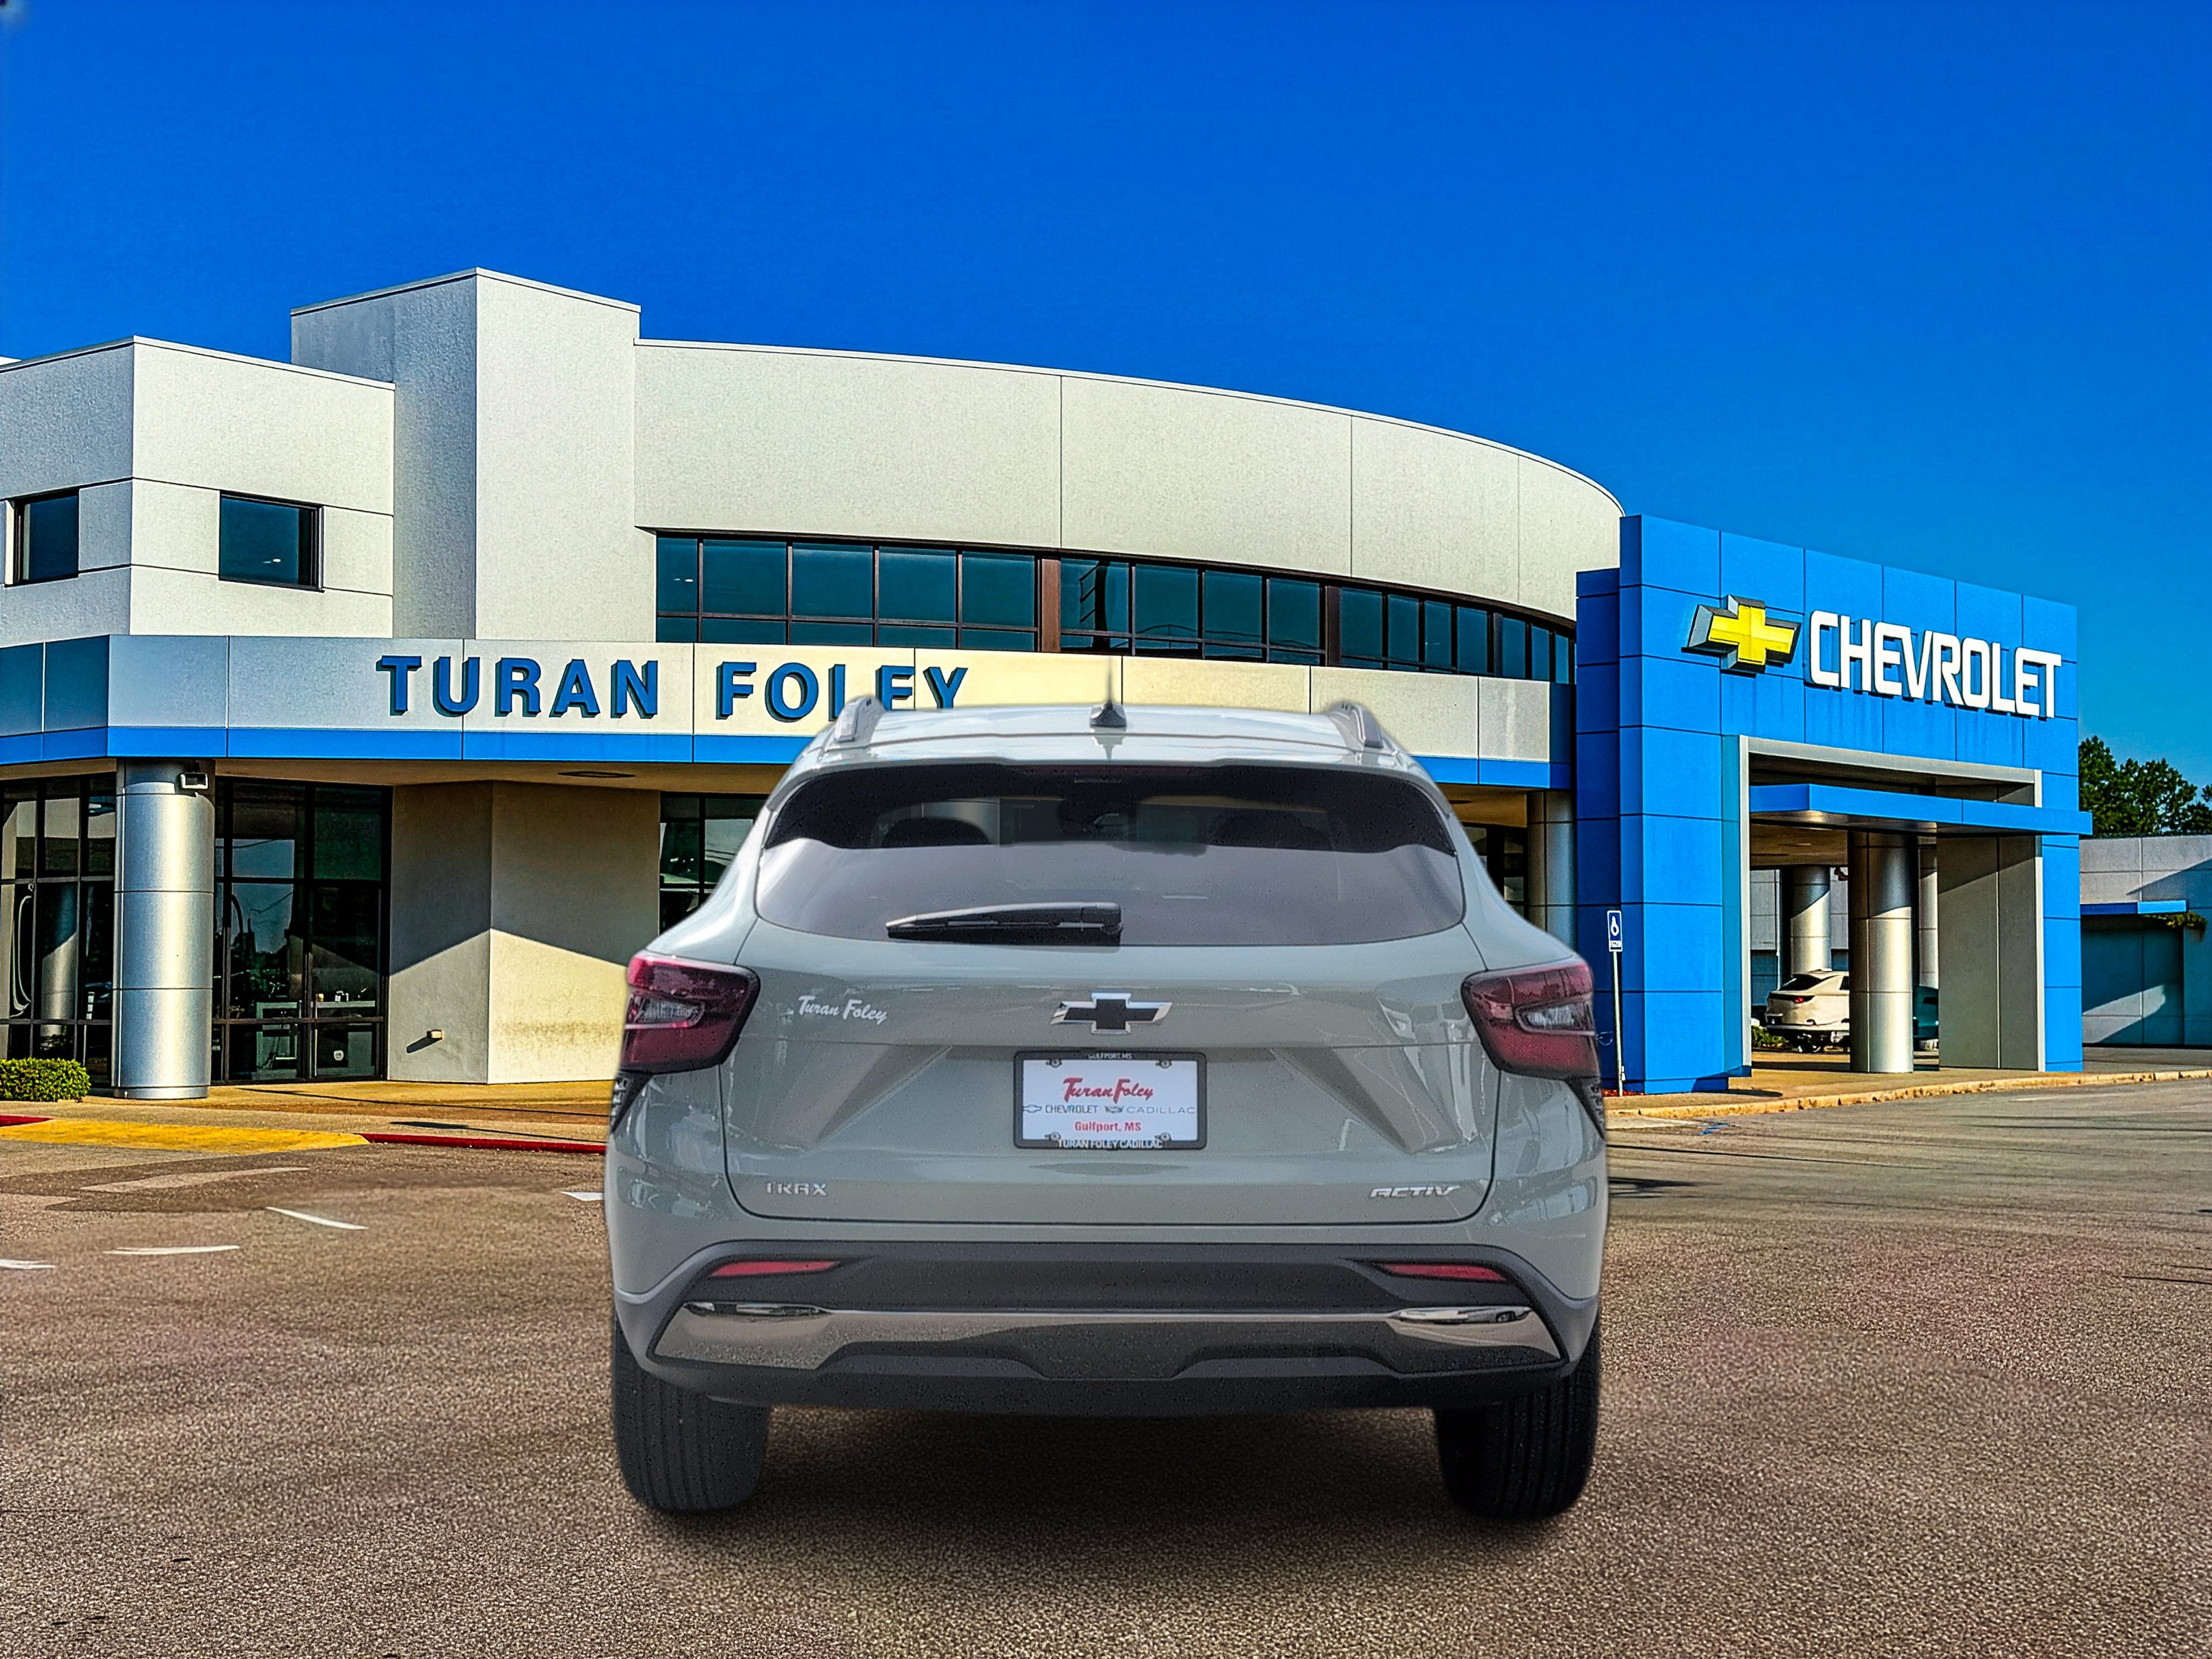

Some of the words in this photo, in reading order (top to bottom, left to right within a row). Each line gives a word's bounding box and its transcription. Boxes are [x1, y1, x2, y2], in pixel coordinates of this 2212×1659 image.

[1810, 610, 2061, 718] CHEVROLET
[376, 655, 658, 718] TURAN
[798, 995, 840, 1015] Turan
[843, 999, 887, 1025] Foley
[1063, 1077, 1114, 1103] Turan
[1111, 1078, 1154, 1104] Foley
[1045, 1105, 1099, 1114] CHEVROLET
[1126, 1106, 1196, 1114] CADILLAC
[1075, 1121, 1122, 1133] Gulfport,
[1124, 1122, 1142, 1131] MS
[1058, 1139, 1089, 1148] TURAN
[1090, 1140, 1119, 1148] FOLEY
[1120, 1140, 1163, 1149] CADILLAC
[1369, 1185, 1461, 1198] ACTIV
